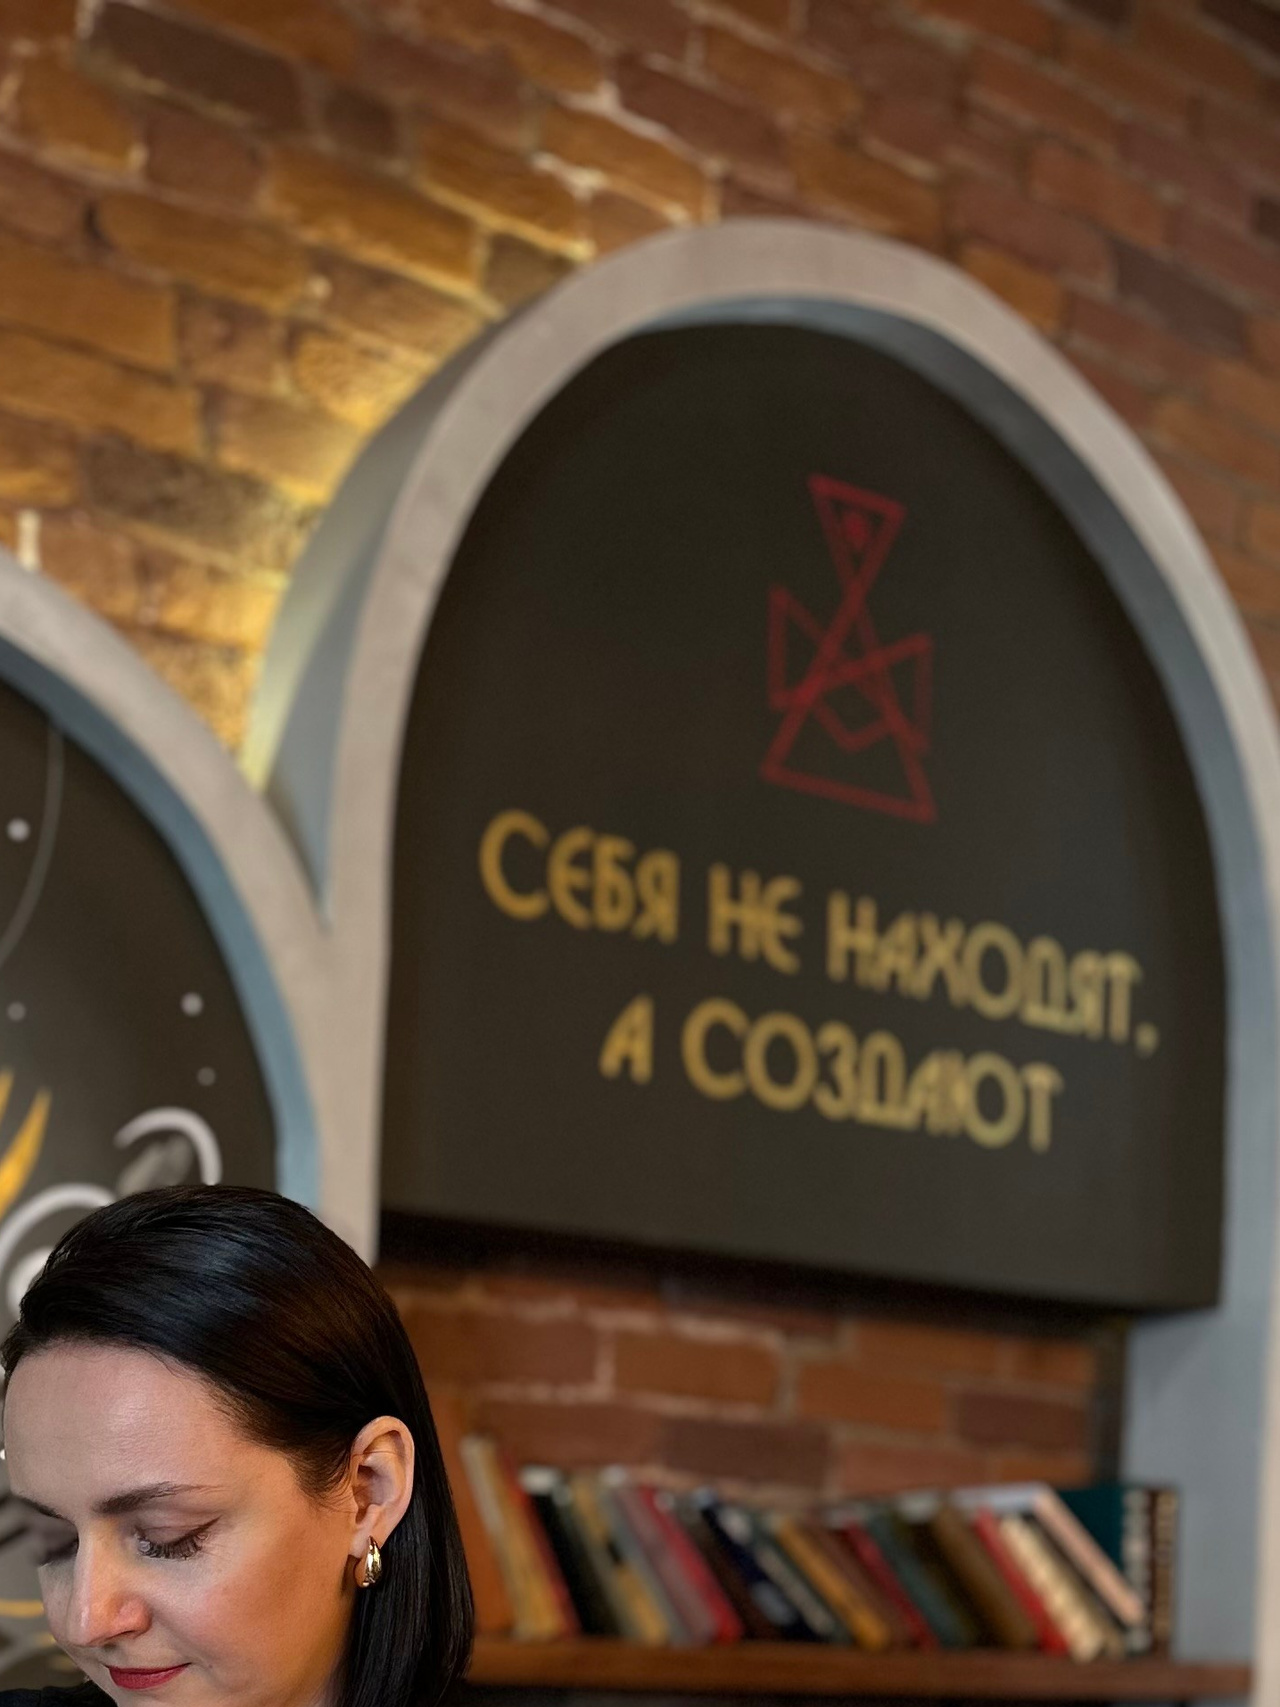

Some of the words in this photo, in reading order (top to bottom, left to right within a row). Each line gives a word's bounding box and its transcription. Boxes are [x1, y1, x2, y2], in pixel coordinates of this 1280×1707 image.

[479, 810, 678, 942] СЕБЯ
[709, 866, 801, 974] НЕ
[828, 892, 1158, 1054] НАХОДЯТ,
[599, 997, 653, 1083] А
[681, 999, 1062, 1150] СОЗДАЮТ
